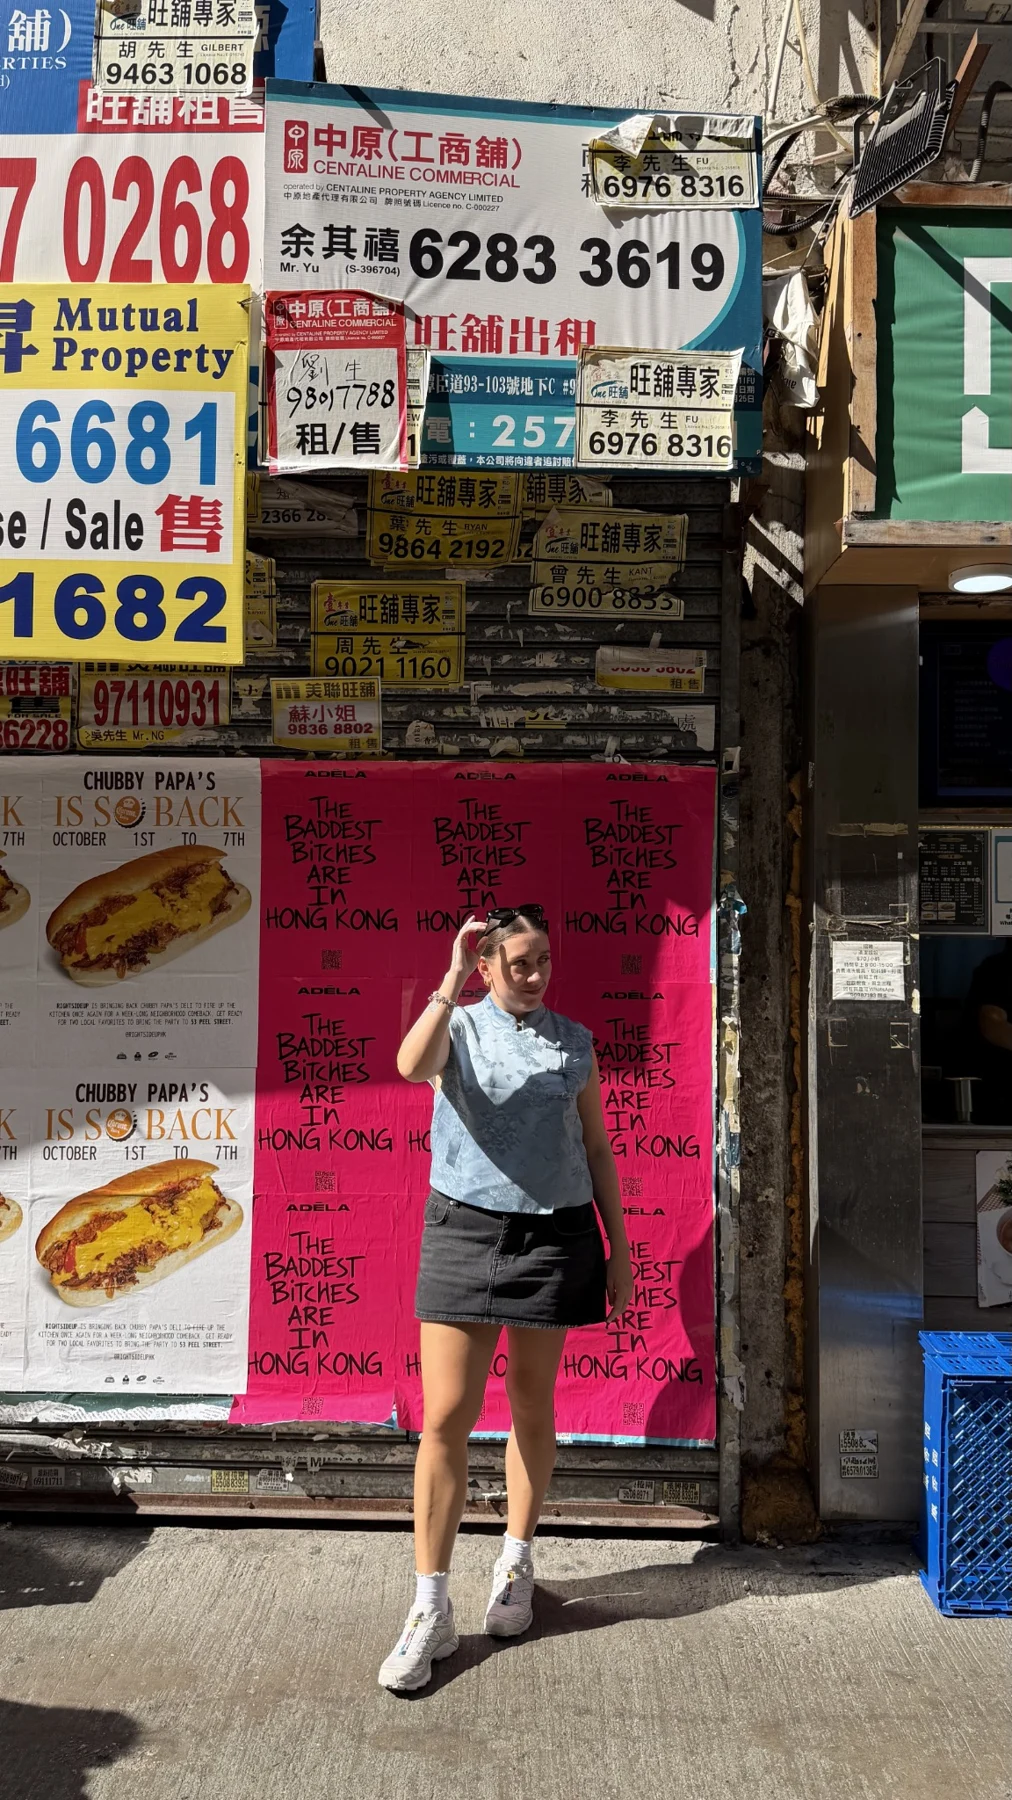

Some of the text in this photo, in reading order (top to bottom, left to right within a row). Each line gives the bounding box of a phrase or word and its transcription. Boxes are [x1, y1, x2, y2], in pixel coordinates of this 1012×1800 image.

[148, 0, 237, 27] 旺舖專家
[119, 41, 194, 58] 胡先生
[0, 56, 67, 70] RTIES
[106, 63, 247, 85] 9463 1068
[314, 123, 522, 171] 中原(工商舖)
[313, 160, 521, 189] CENTALINE COMMERCIAL
[614, 154, 690, 172] 李先生
[283, 183, 504, 203] operated by CENTALINE PROPERTY AGENCY LIMITED
[604, 175, 744, 198] 6976 8316
[283, 191, 378, 205] 中原地產代理有限公司
[423, 201, 452, 210] Licence
[466, 203, 500, 212] C-000227
[63, 155, 251, 284] 0268
[280, 223, 726, 292] 余其禧 6283 3619
[280, 262, 401, 278] Mr. Yu (S-396704)
[54, 298, 199, 333] Mutual
[338, 319, 397, 327] COMMERCIAL
[415, 314, 596, 357] 旺舖出租
[52, 337, 234, 379] Property
[630, 364, 720, 399] 旺舖專家
[287, 379, 397, 419] 98017788
[601, 409, 678, 430] 李先生
[685, 415, 699, 423] FU
[15, 399, 218, 486] 6681
[296, 422, 381, 456] 租/售
[589, 431, 732, 459] 6976 8316
[416, 475, 498, 508] 旺舖專家
[65, 494, 224, 554] Sale 售
[261, 509, 302, 523] 2366
[379, 533, 442, 560] 9864
[449, 539, 505, 559] 2192
[580, 521, 663, 555] 旺舖專家
[550, 564, 654, 585] 曾先生 KANT
[0, 572, 228, 643] 1682
[541, 586, 602, 608] 6900
[360, 594, 441, 625] 旺舖專家
[336, 636, 408, 655] 周先生
[325, 657, 451, 680] 9021 1160
[305, 681, 376, 698] 美聯旺舖
[94, 680, 219, 726] 97110931
[288, 704, 357, 722] 蘇小姐
[287, 723, 373, 736] 9836 8802
[84, 771, 216, 790] CHUBBY PAPA'S
[54, 795, 245, 827] IS BACK
[308, 796, 353, 819] THE
[458, 798, 502, 821] THE
[610, 799, 654, 823] THE
[3, 832, 25, 845] 7TH
[53, 832, 245, 846] OCTOBER 1ST TO 7TH
[283, 814, 383, 842] BADDEST
[432, 816, 532, 845] BADDEST
[583, 818, 684, 846] BADDEST
[306, 865, 352, 885] ARE
[457, 867, 502, 888] ARE
[607, 869, 652, 890] ARE
[265, 907, 399, 932] HONG KONG
[565, 911, 700, 938] HONG KONG
[302, 1013, 347, 1037] THE
[605, 1018, 652, 1041] THE
[276, 1032, 377, 1061] BADDEST
[76, 1083, 209, 1102] CHUBBY PAPA'S
[299, 1083, 346, 1104] ARE
[605, 1088, 652, 1110] ARE
[45, 1108, 238, 1140] IS BACK
[258, 1128, 393, 1152] HONG KONG
[635, 1135, 701, 1159] KONG
[0, 1146, 17, 1160] TH
[43, 1146, 238, 1160] OCTOBER 1ST TO 7TH
[289, 1231, 335, 1255] THE
[263, 1251, 366, 1281] BADDEST
[288, 1305, 335, 1326] ARE
[248, 1350, 309, 1376] HONG
[317, 1351, 382, 1377] KONG
[564, 1354, 703, 1385] HONG KONG
